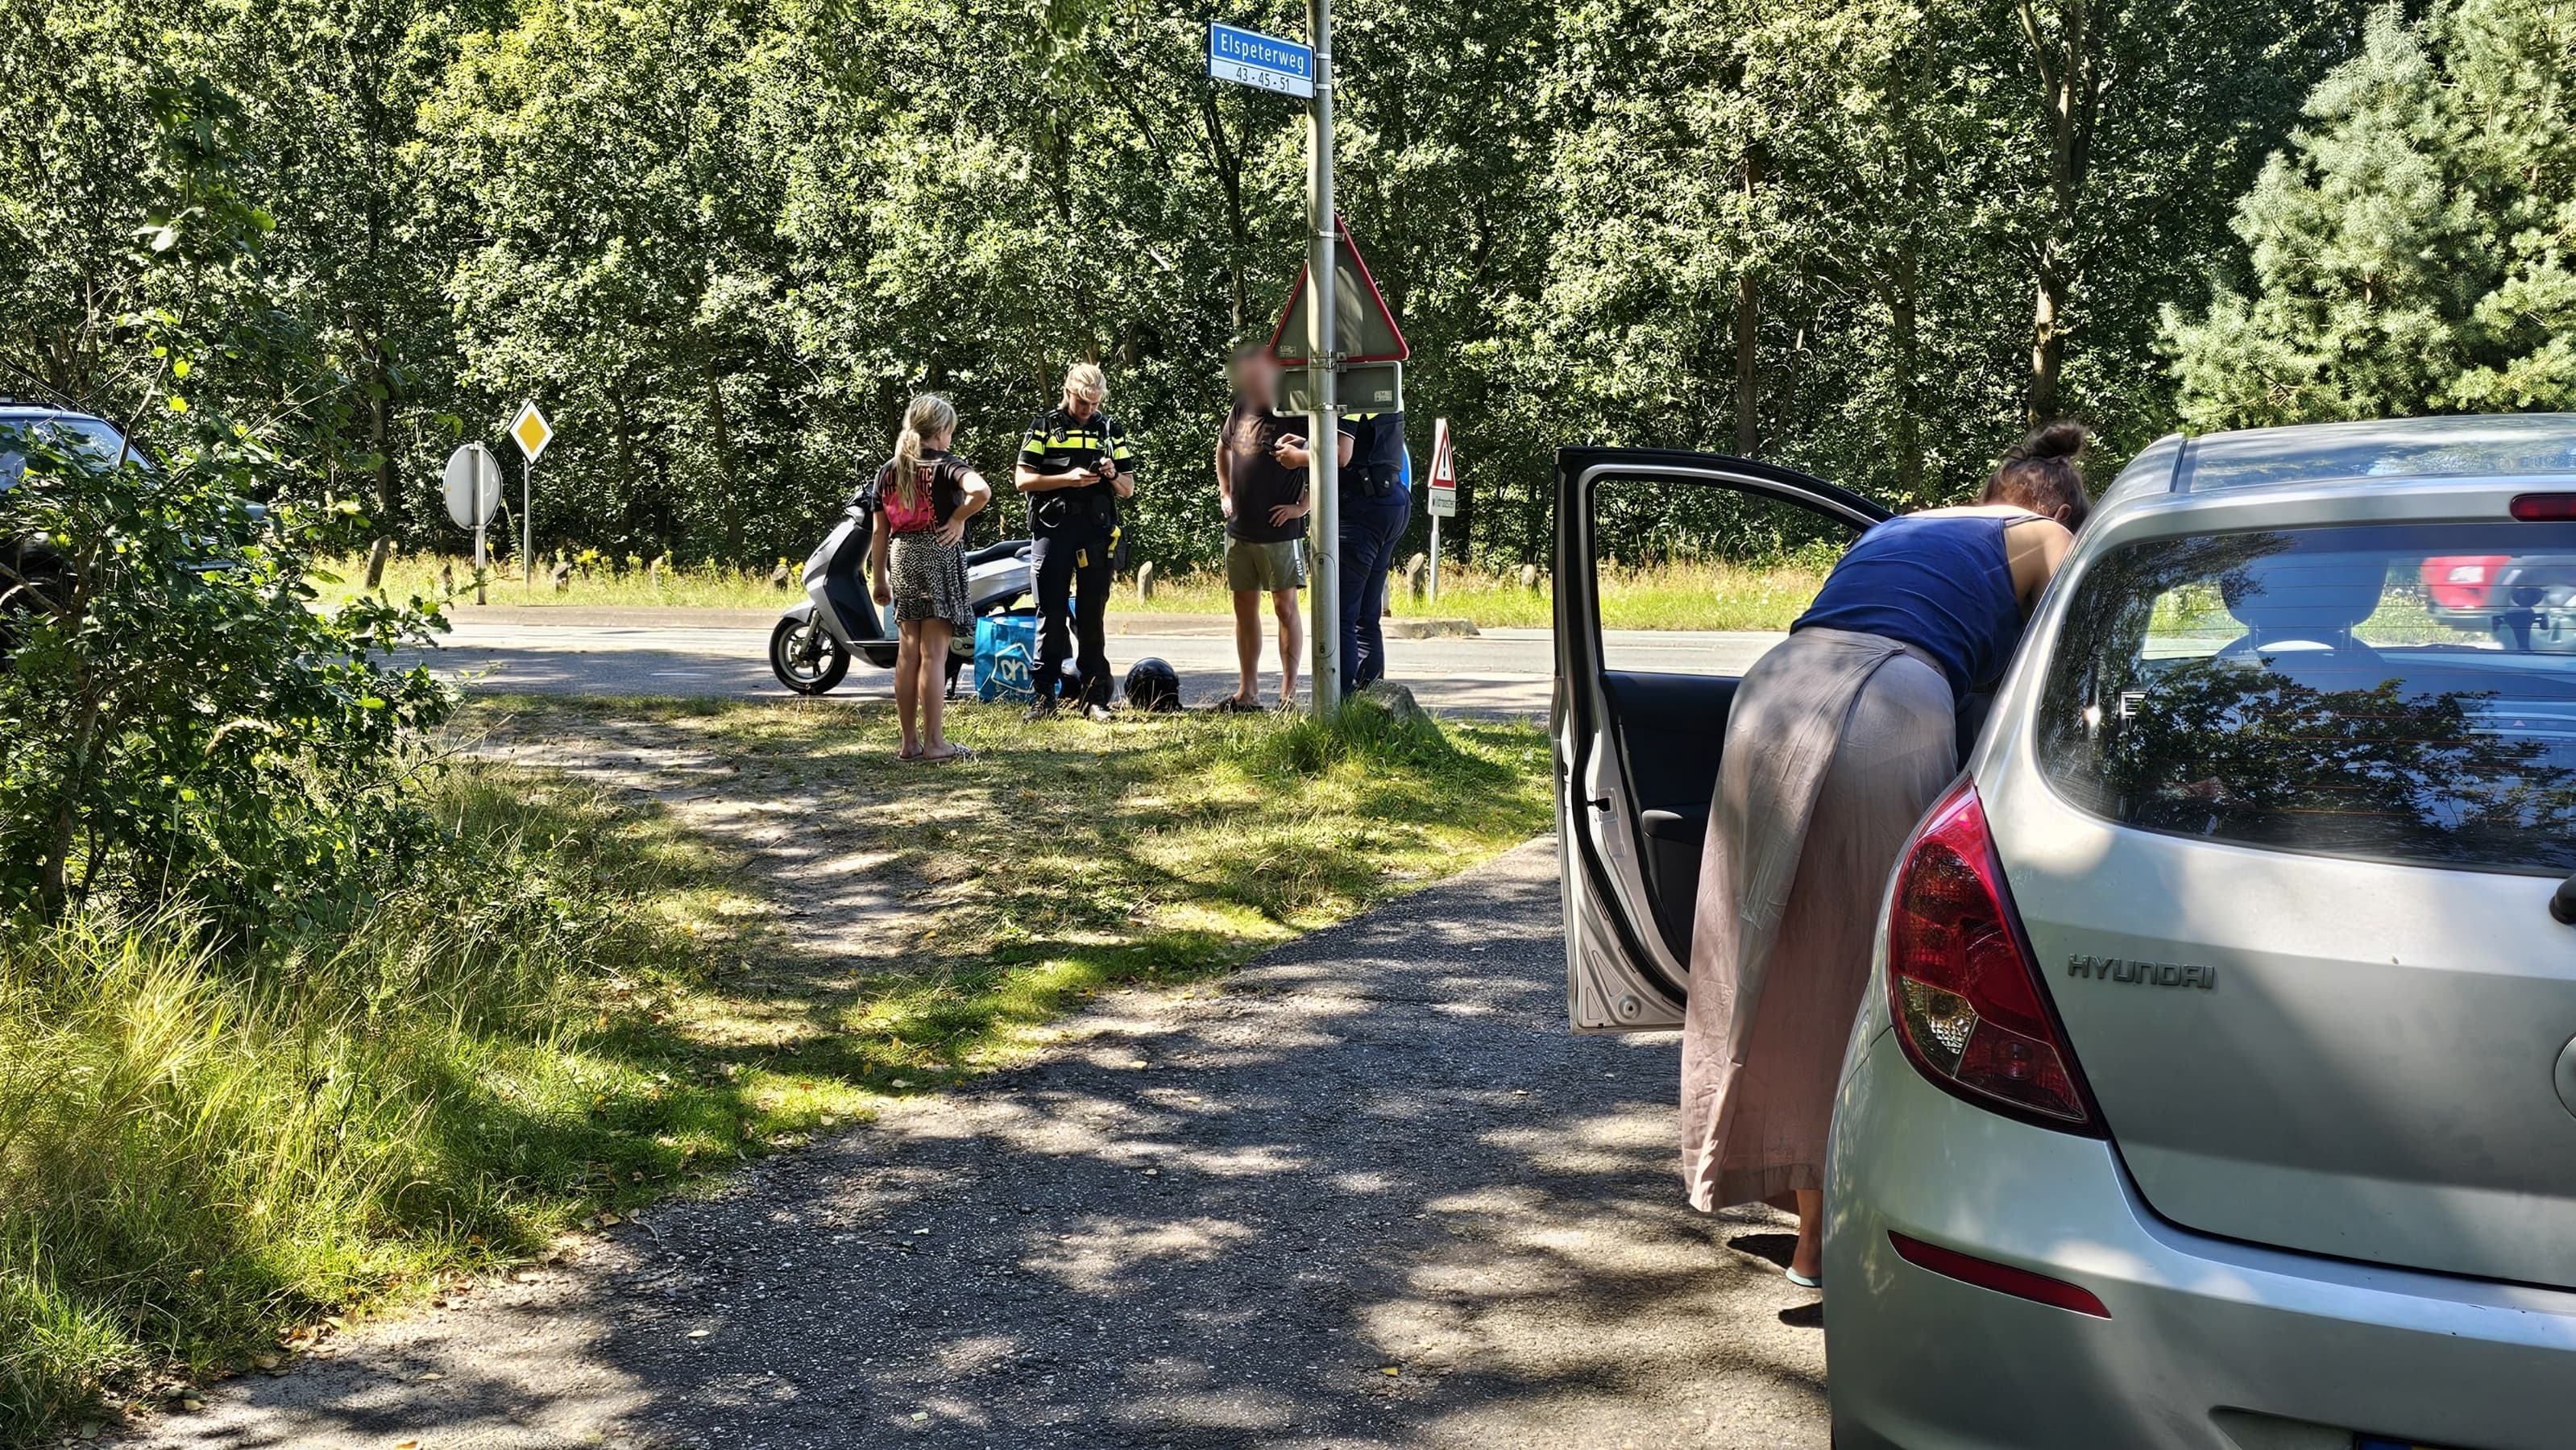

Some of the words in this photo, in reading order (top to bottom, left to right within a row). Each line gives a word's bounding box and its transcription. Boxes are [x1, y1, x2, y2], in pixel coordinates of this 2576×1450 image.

[1221, 33, 1304, 74] Elspeterweg
[1236, 67, 1248, 82] 43
[1259, 72, 1270, 87] 45
[1280, 77, 1290, 91] 51
[2068, 953, 2215, 989] HYUNDAI
